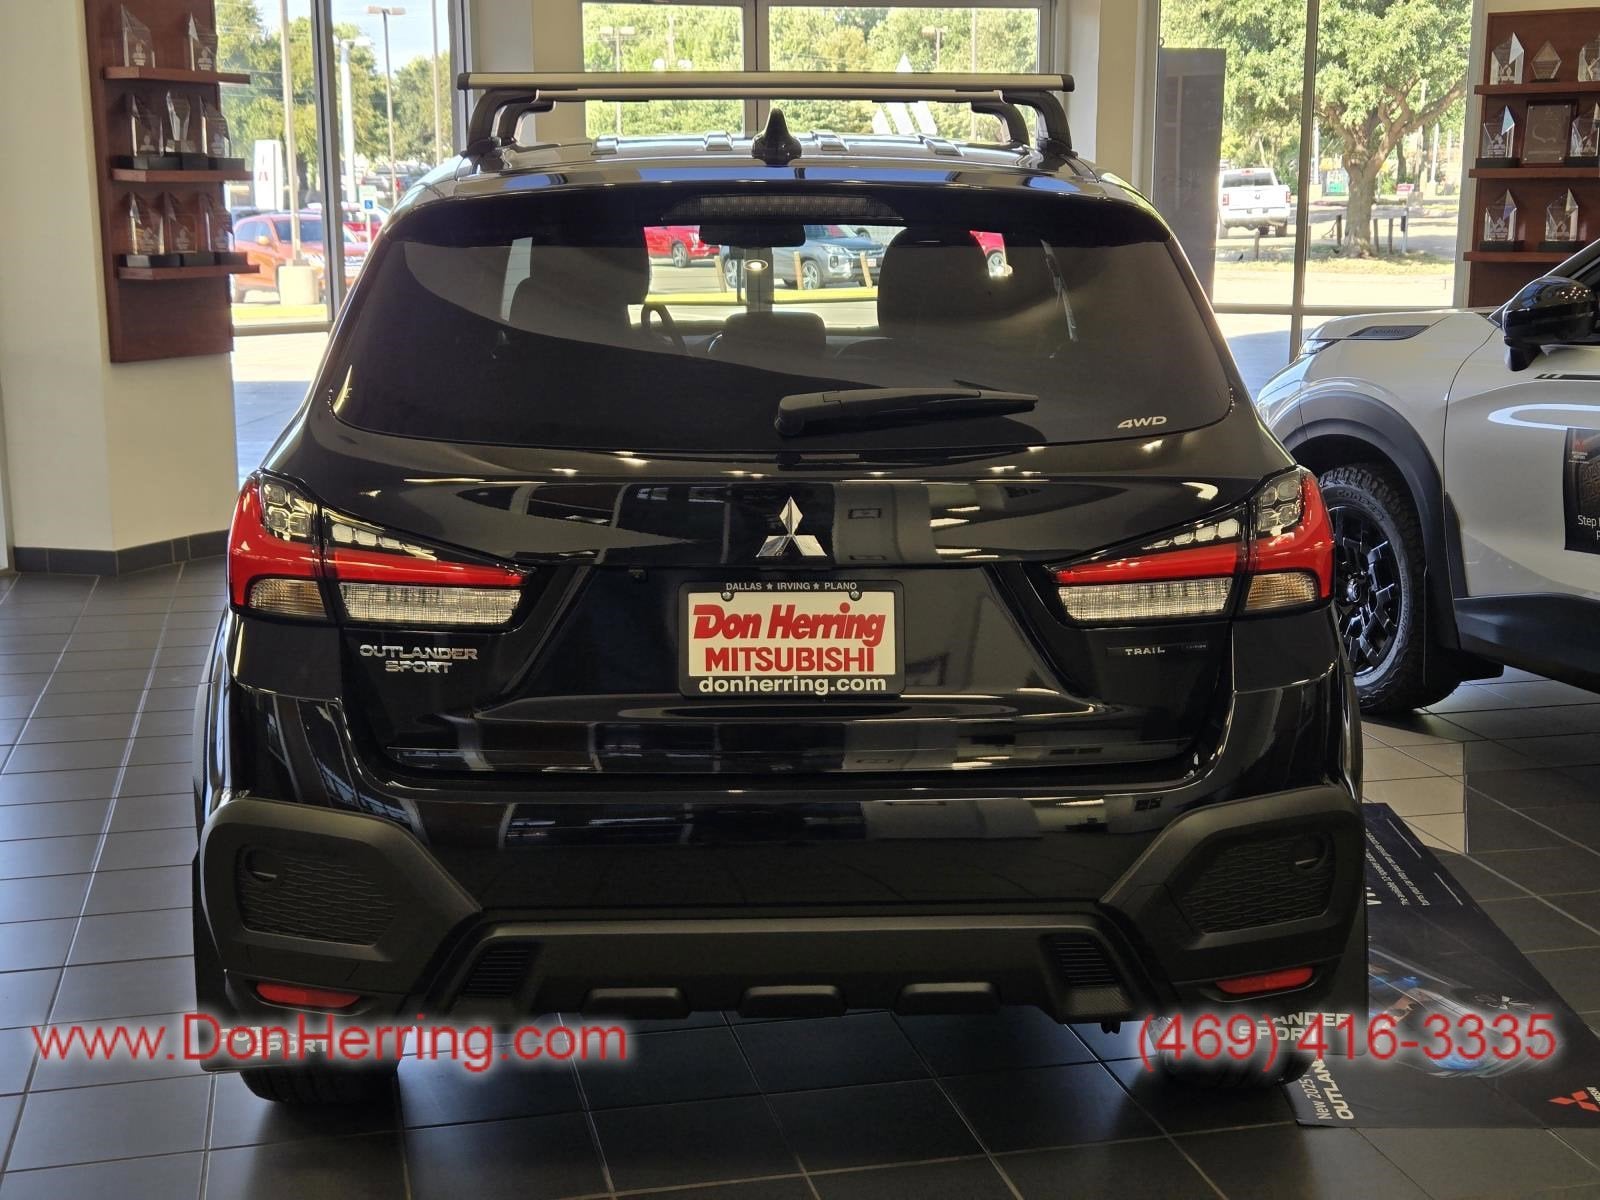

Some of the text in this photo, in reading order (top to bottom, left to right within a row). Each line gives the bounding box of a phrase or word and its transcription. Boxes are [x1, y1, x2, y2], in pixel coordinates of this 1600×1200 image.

[1117, 415, 1167, 429] 4WD
[1577, 514, 1597, 529] Step
[726, 581, 857, 591] DALLAS IRVING PLANO
[693, 602, 886, 647] Don Herring
[359, 644, 479, 660] OUTLANDER
[1124, 646, 1166, 656] TRAIL
[385, 660, 453, 674] SPORT
[705, 647, 875, 672] MITSUBISHI
[699, 676, 887, 696] donherring.com
[1299, 1078, 1333, 1120] New 2025
